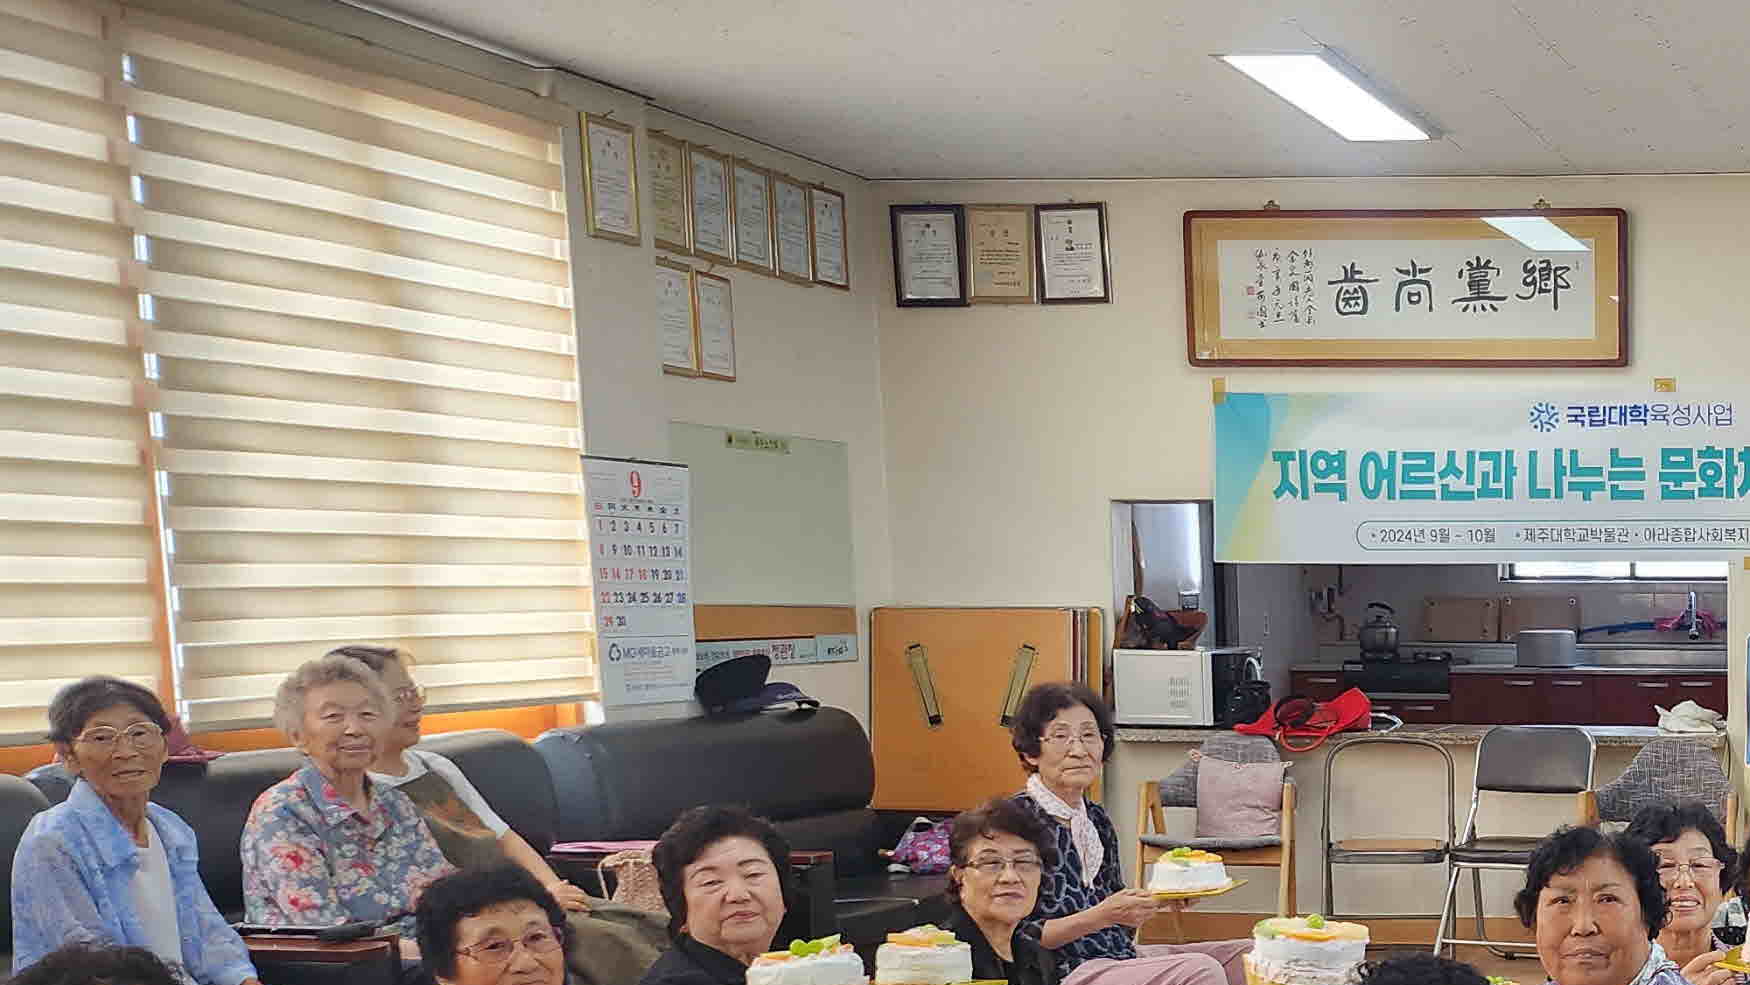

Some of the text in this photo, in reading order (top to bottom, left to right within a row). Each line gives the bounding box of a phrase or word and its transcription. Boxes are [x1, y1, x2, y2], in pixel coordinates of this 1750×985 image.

[1566, 403, 1736, 427] 국립대학육성사업
[630, 471, 642, 497] 9
[1272, 448, 1348, 502] 지역
[1358, 448, 1517, 502] 어르신과
[1527, 448, 1646, 501] 나누는
[1379, 528, 1426, 544] 2024년
[1430, 528, 1451, 543] 9월
[1468, 528, 1496, 543] 10월
[1523, 527, 1630, 544] 제주대학교박물관
